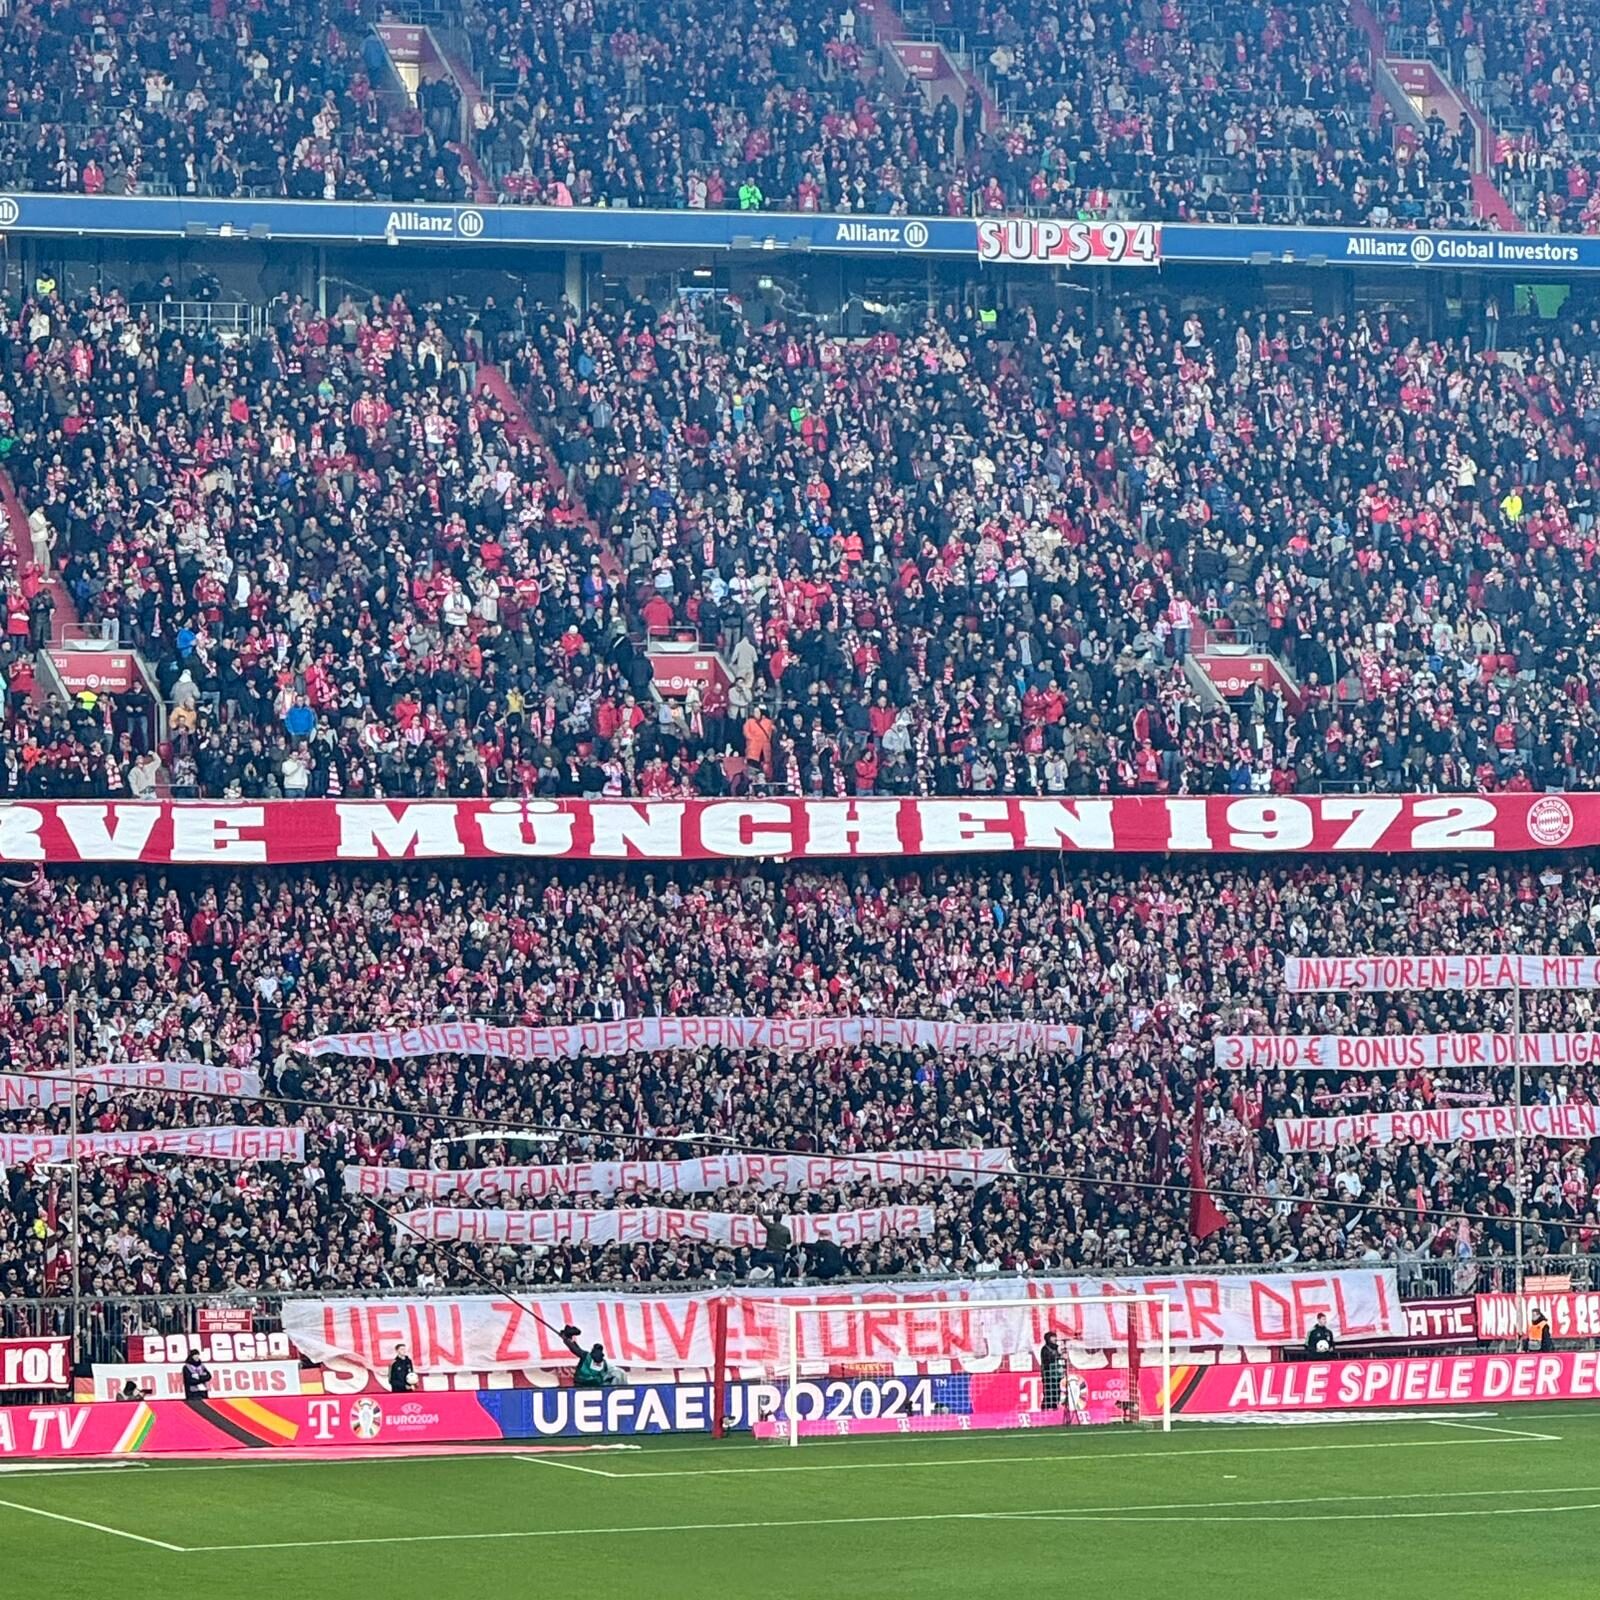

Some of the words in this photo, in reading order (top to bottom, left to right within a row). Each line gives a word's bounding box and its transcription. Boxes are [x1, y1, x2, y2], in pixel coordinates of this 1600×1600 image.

[387, 212, 453, 231] Allianz
[836, 223, 900, 242] Allianz
[979, 220, 1091, 260] SUPS
[1102, 223, 1157, 261] 94
[1347, 238, 1407, 256] Allianz
[1437, 240, 1494, 258] Global
[1498, 242, 1579, 261] Investors
[101, 675, 127, 686] Arena
[336, 800, 1114, 859] MÜNCHEN
[1166, 797, 1497, 850] 1972
[1543, 956, 1584, 987] MIT
[581, 1020, 644, 1053] DER
[1225, 1038, 1244, 1068] 3
[1338, 1036, 1425, 1067] BONUS
[1436, 1033, 1486, 1066] FÜR
[701, 1156, 789, 1187] FÜRS
[410, 1209, 596, 1243] SCHLECHT
[619, 1209, 709, 1242] FÜRS
[1250, 1275, 1391, 1342] DFL!
[5, 1342, 69, 1384] rot
[1228, 1364, 1331, 1407] ALLE
[1338, 1359, 1475, 1403] SPIELE
[1482, 1357, 1563, 1397] DER
[28, 1407, 91, 1451] TV
